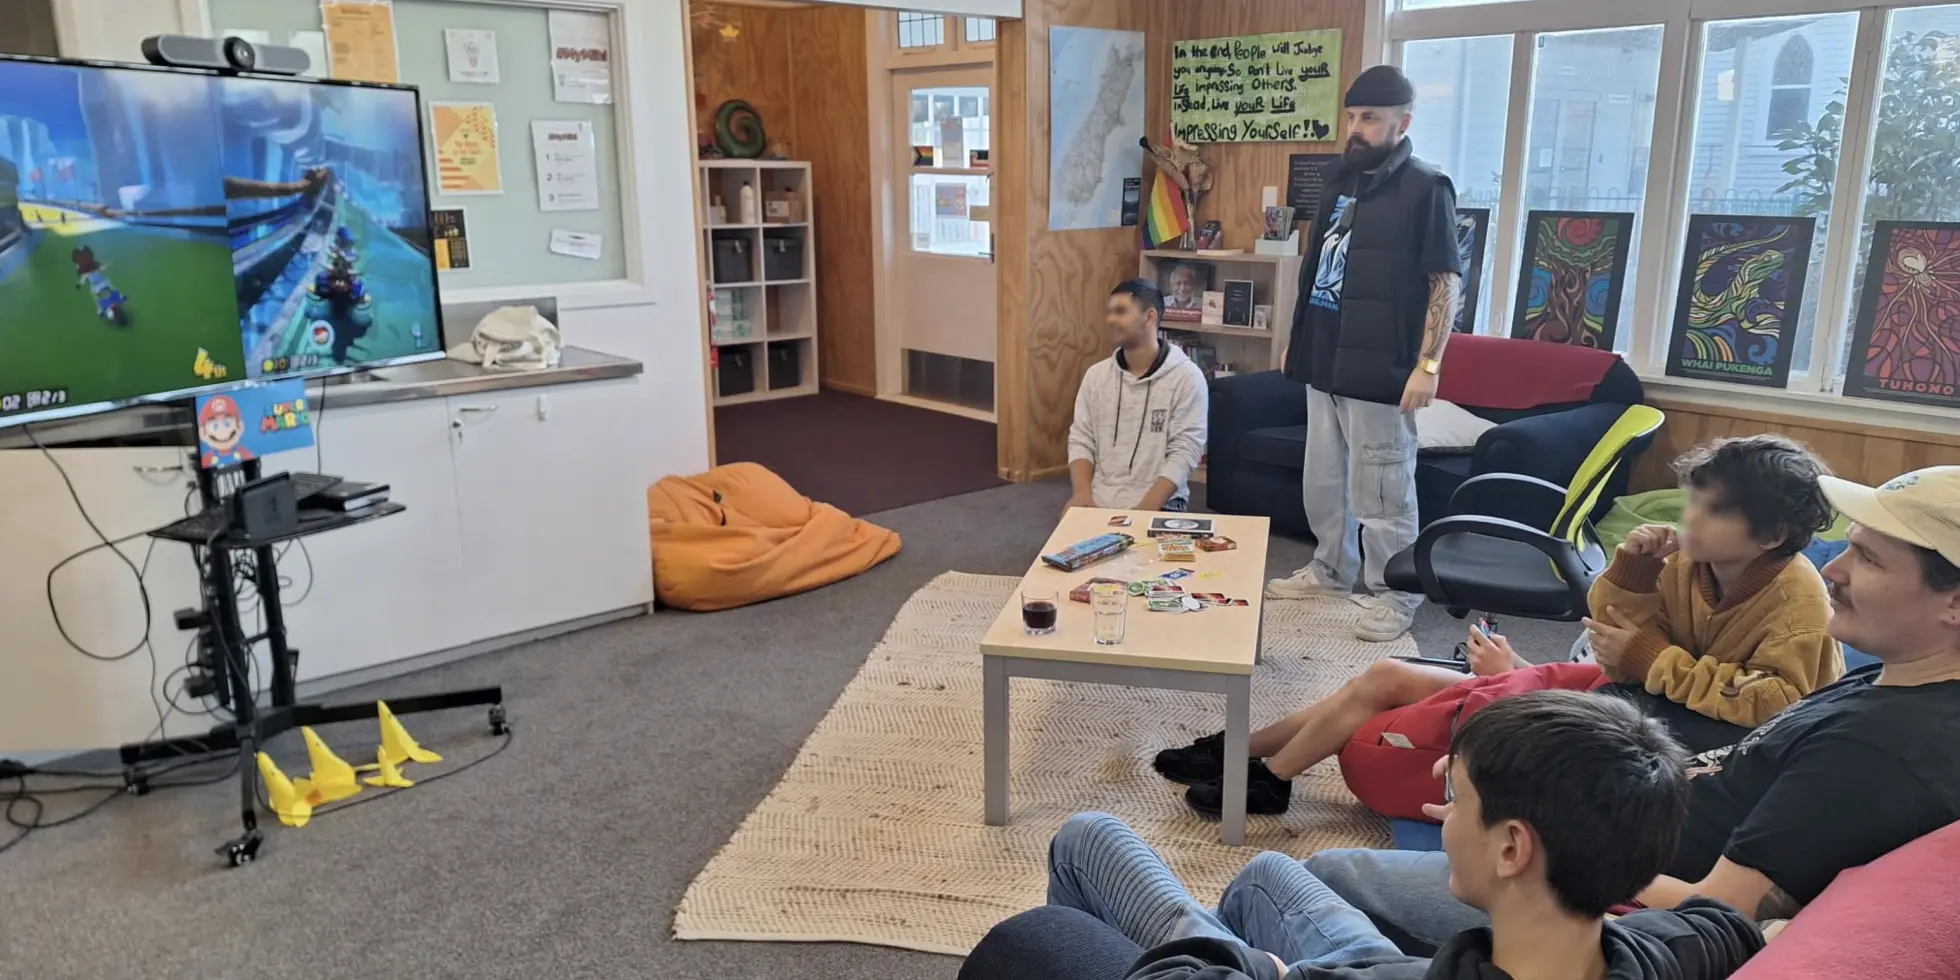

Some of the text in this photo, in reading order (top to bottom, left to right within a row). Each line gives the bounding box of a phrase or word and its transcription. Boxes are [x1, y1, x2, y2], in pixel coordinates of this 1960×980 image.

[1174, 45, 1187, 59] In
[1192, 44, 1208, 58] the
[1294, 41, 1323, 58] Judge
[1173, 66, 1191, 80] you
[1682, 359, 1713, 370] WHAI
[1715, 361, 1773, 376] PUKENGA
[1880, 379, 1955, 396] TUHONO
[260, 411, 312, 434] MARIO
